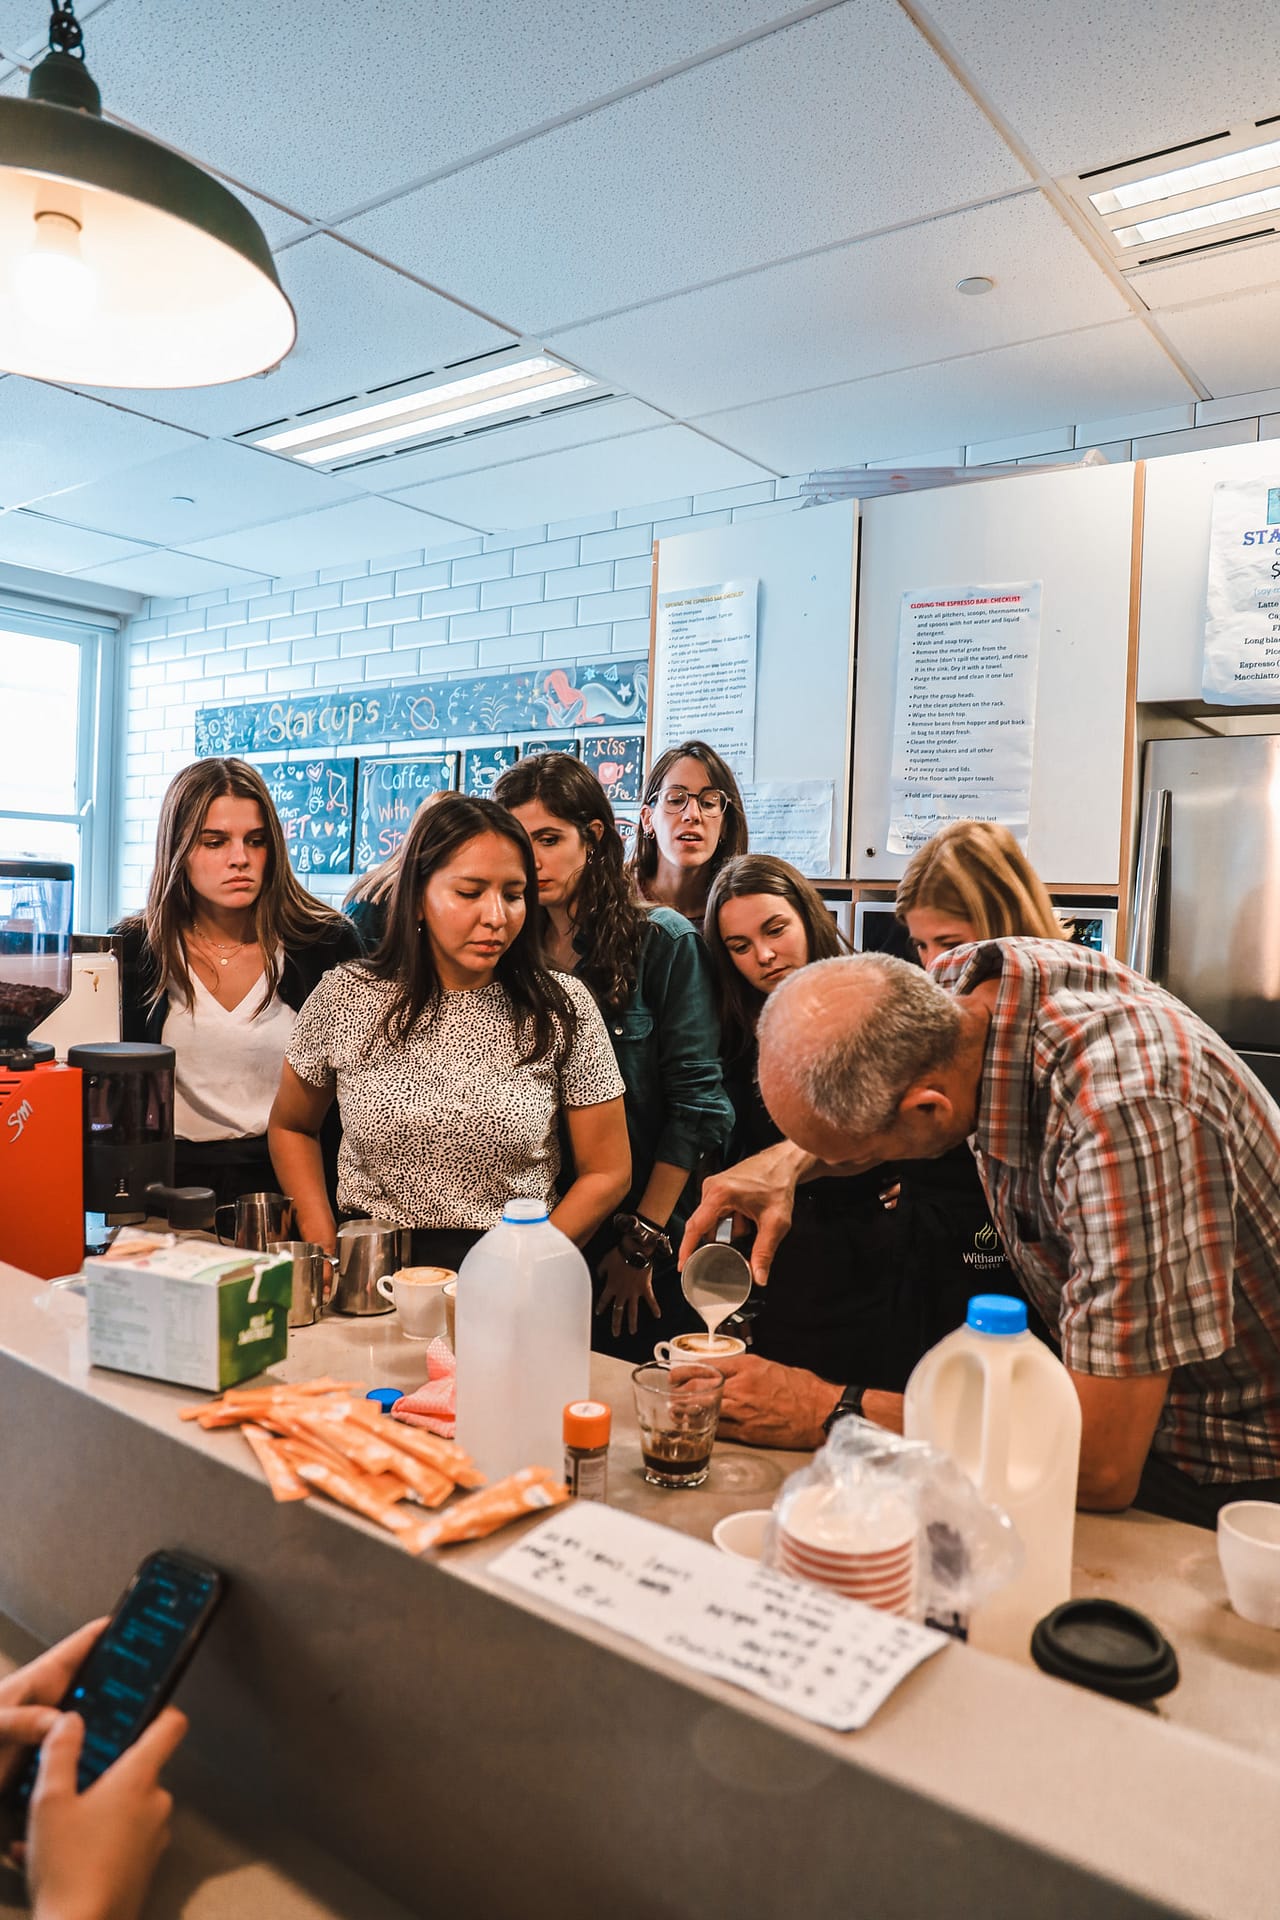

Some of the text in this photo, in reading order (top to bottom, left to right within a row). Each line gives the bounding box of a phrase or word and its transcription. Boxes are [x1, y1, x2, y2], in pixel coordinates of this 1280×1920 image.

[991, 596, 1020, 604] CHECKLIST
[1257, 601, 1279, 609] Latte
[989, 607, 1030, 615] thermometers
[1267, 612, 1280, 621] Ca
[1244, 637, 1265, 646] Long
[1239, 661, 1276, 670] Espresso
[268, 699, 380, 743] Starcups
[592, 736, 625, 757] Kiss
[381, 765, 430, 790] Coffee
[378, 798, 410, 823] With
